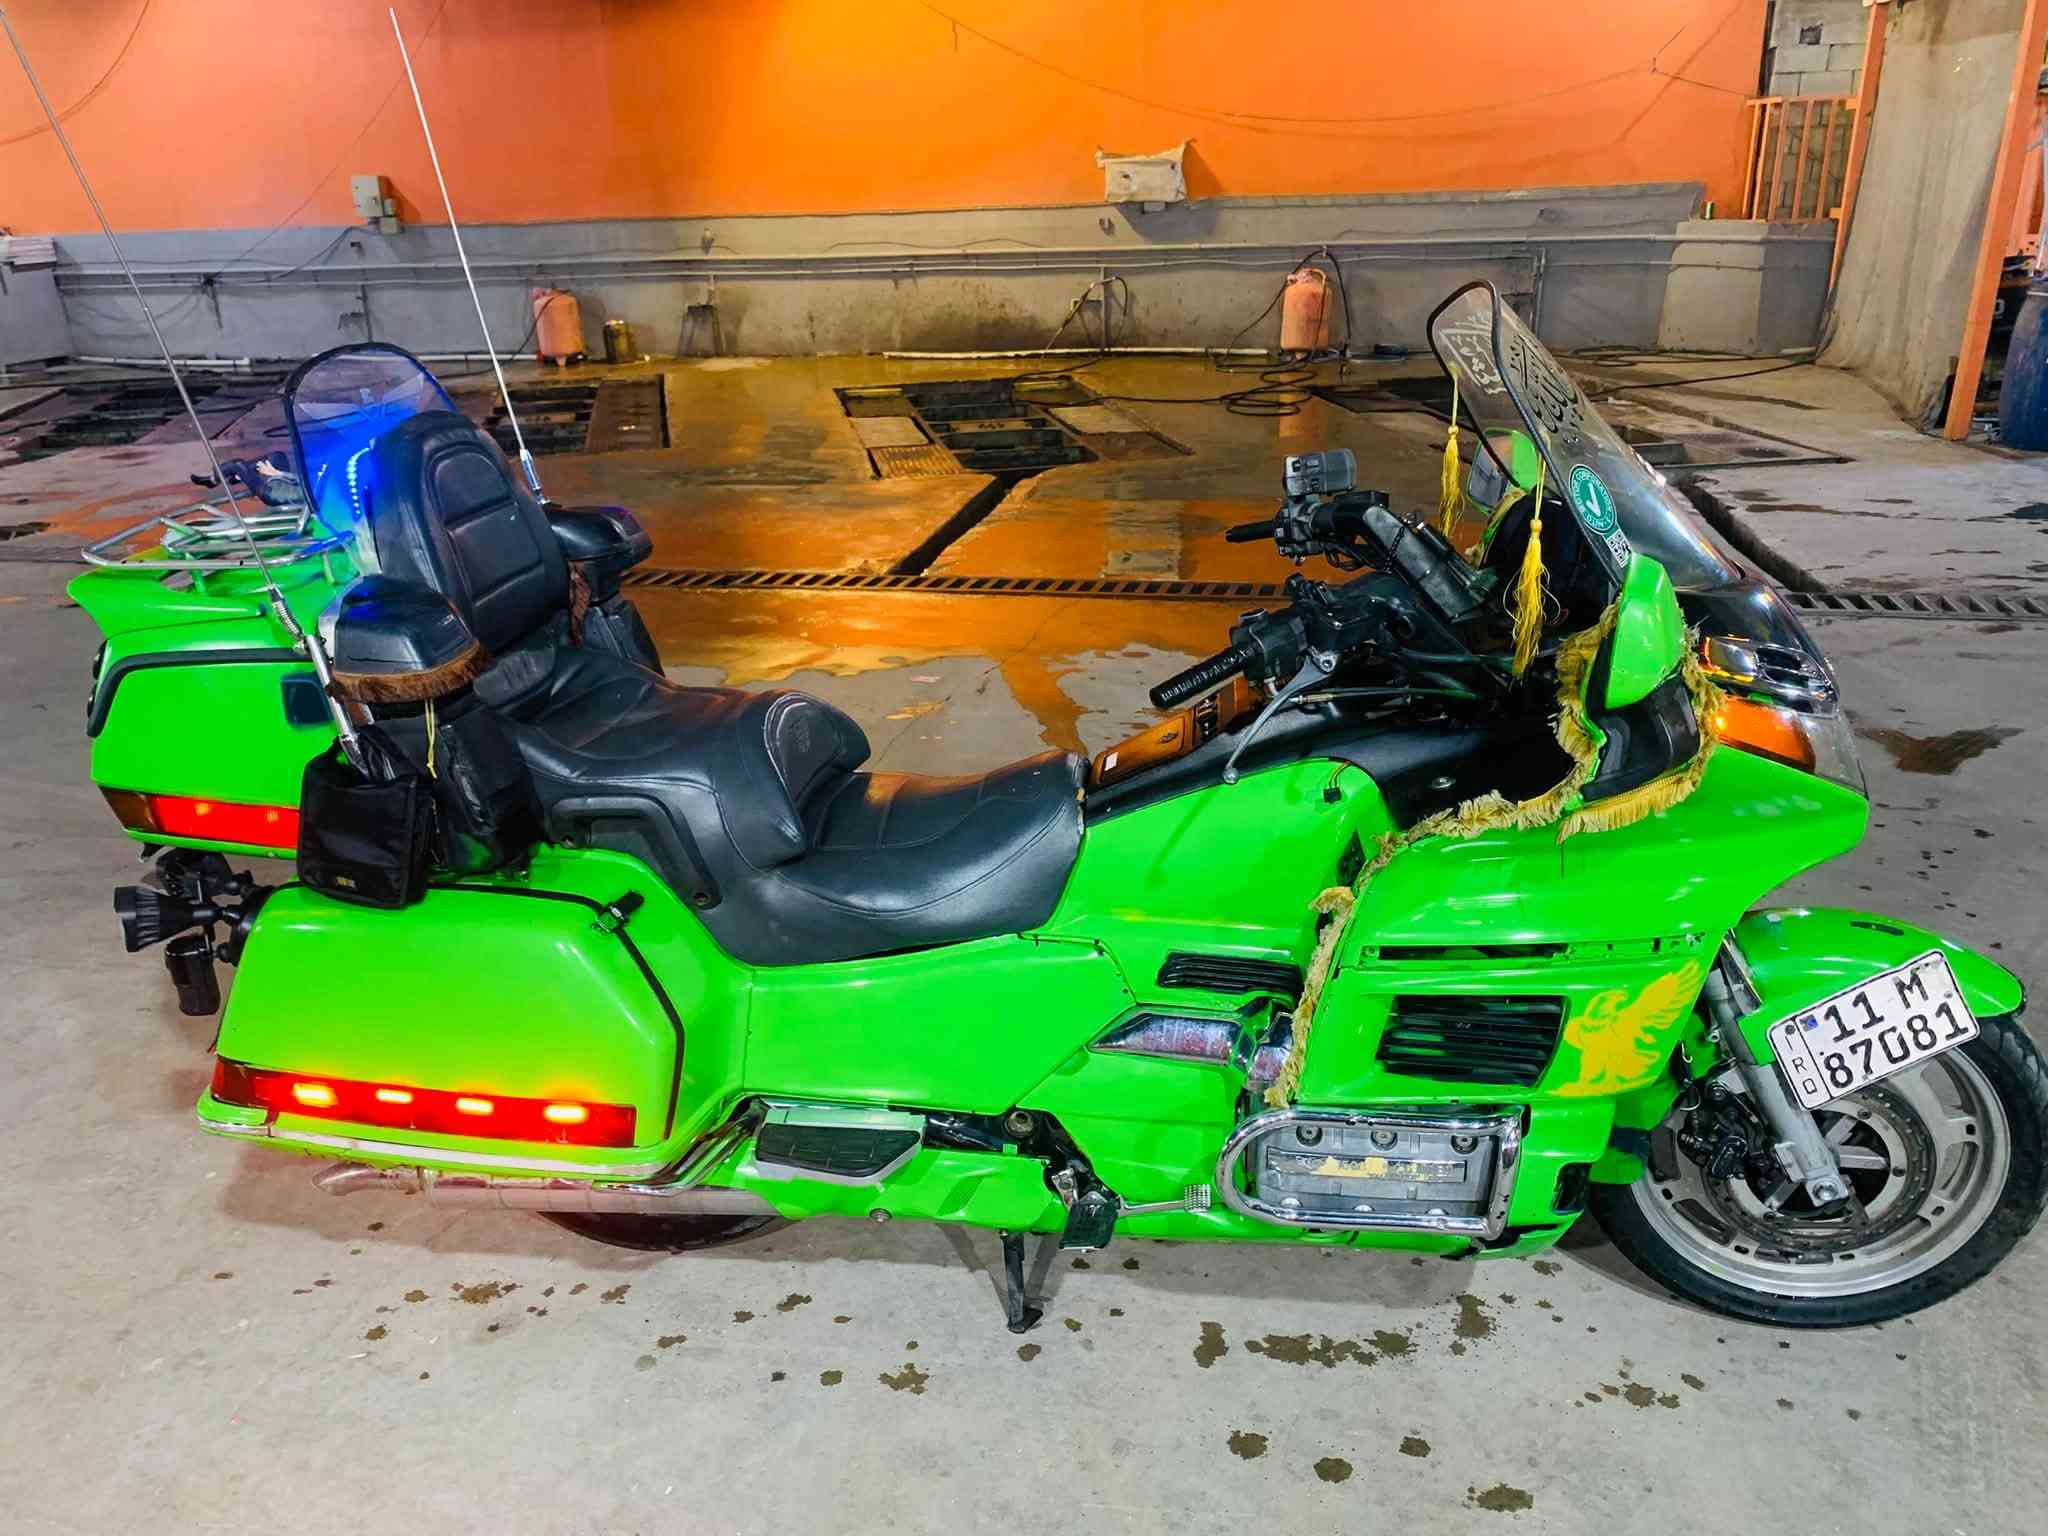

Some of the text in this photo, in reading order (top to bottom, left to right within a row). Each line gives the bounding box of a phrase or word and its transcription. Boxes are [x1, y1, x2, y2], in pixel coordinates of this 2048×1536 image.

[1824, 968, 1929, 1042] 11 M
[1824, 1002, 1969, 1089] 87081
